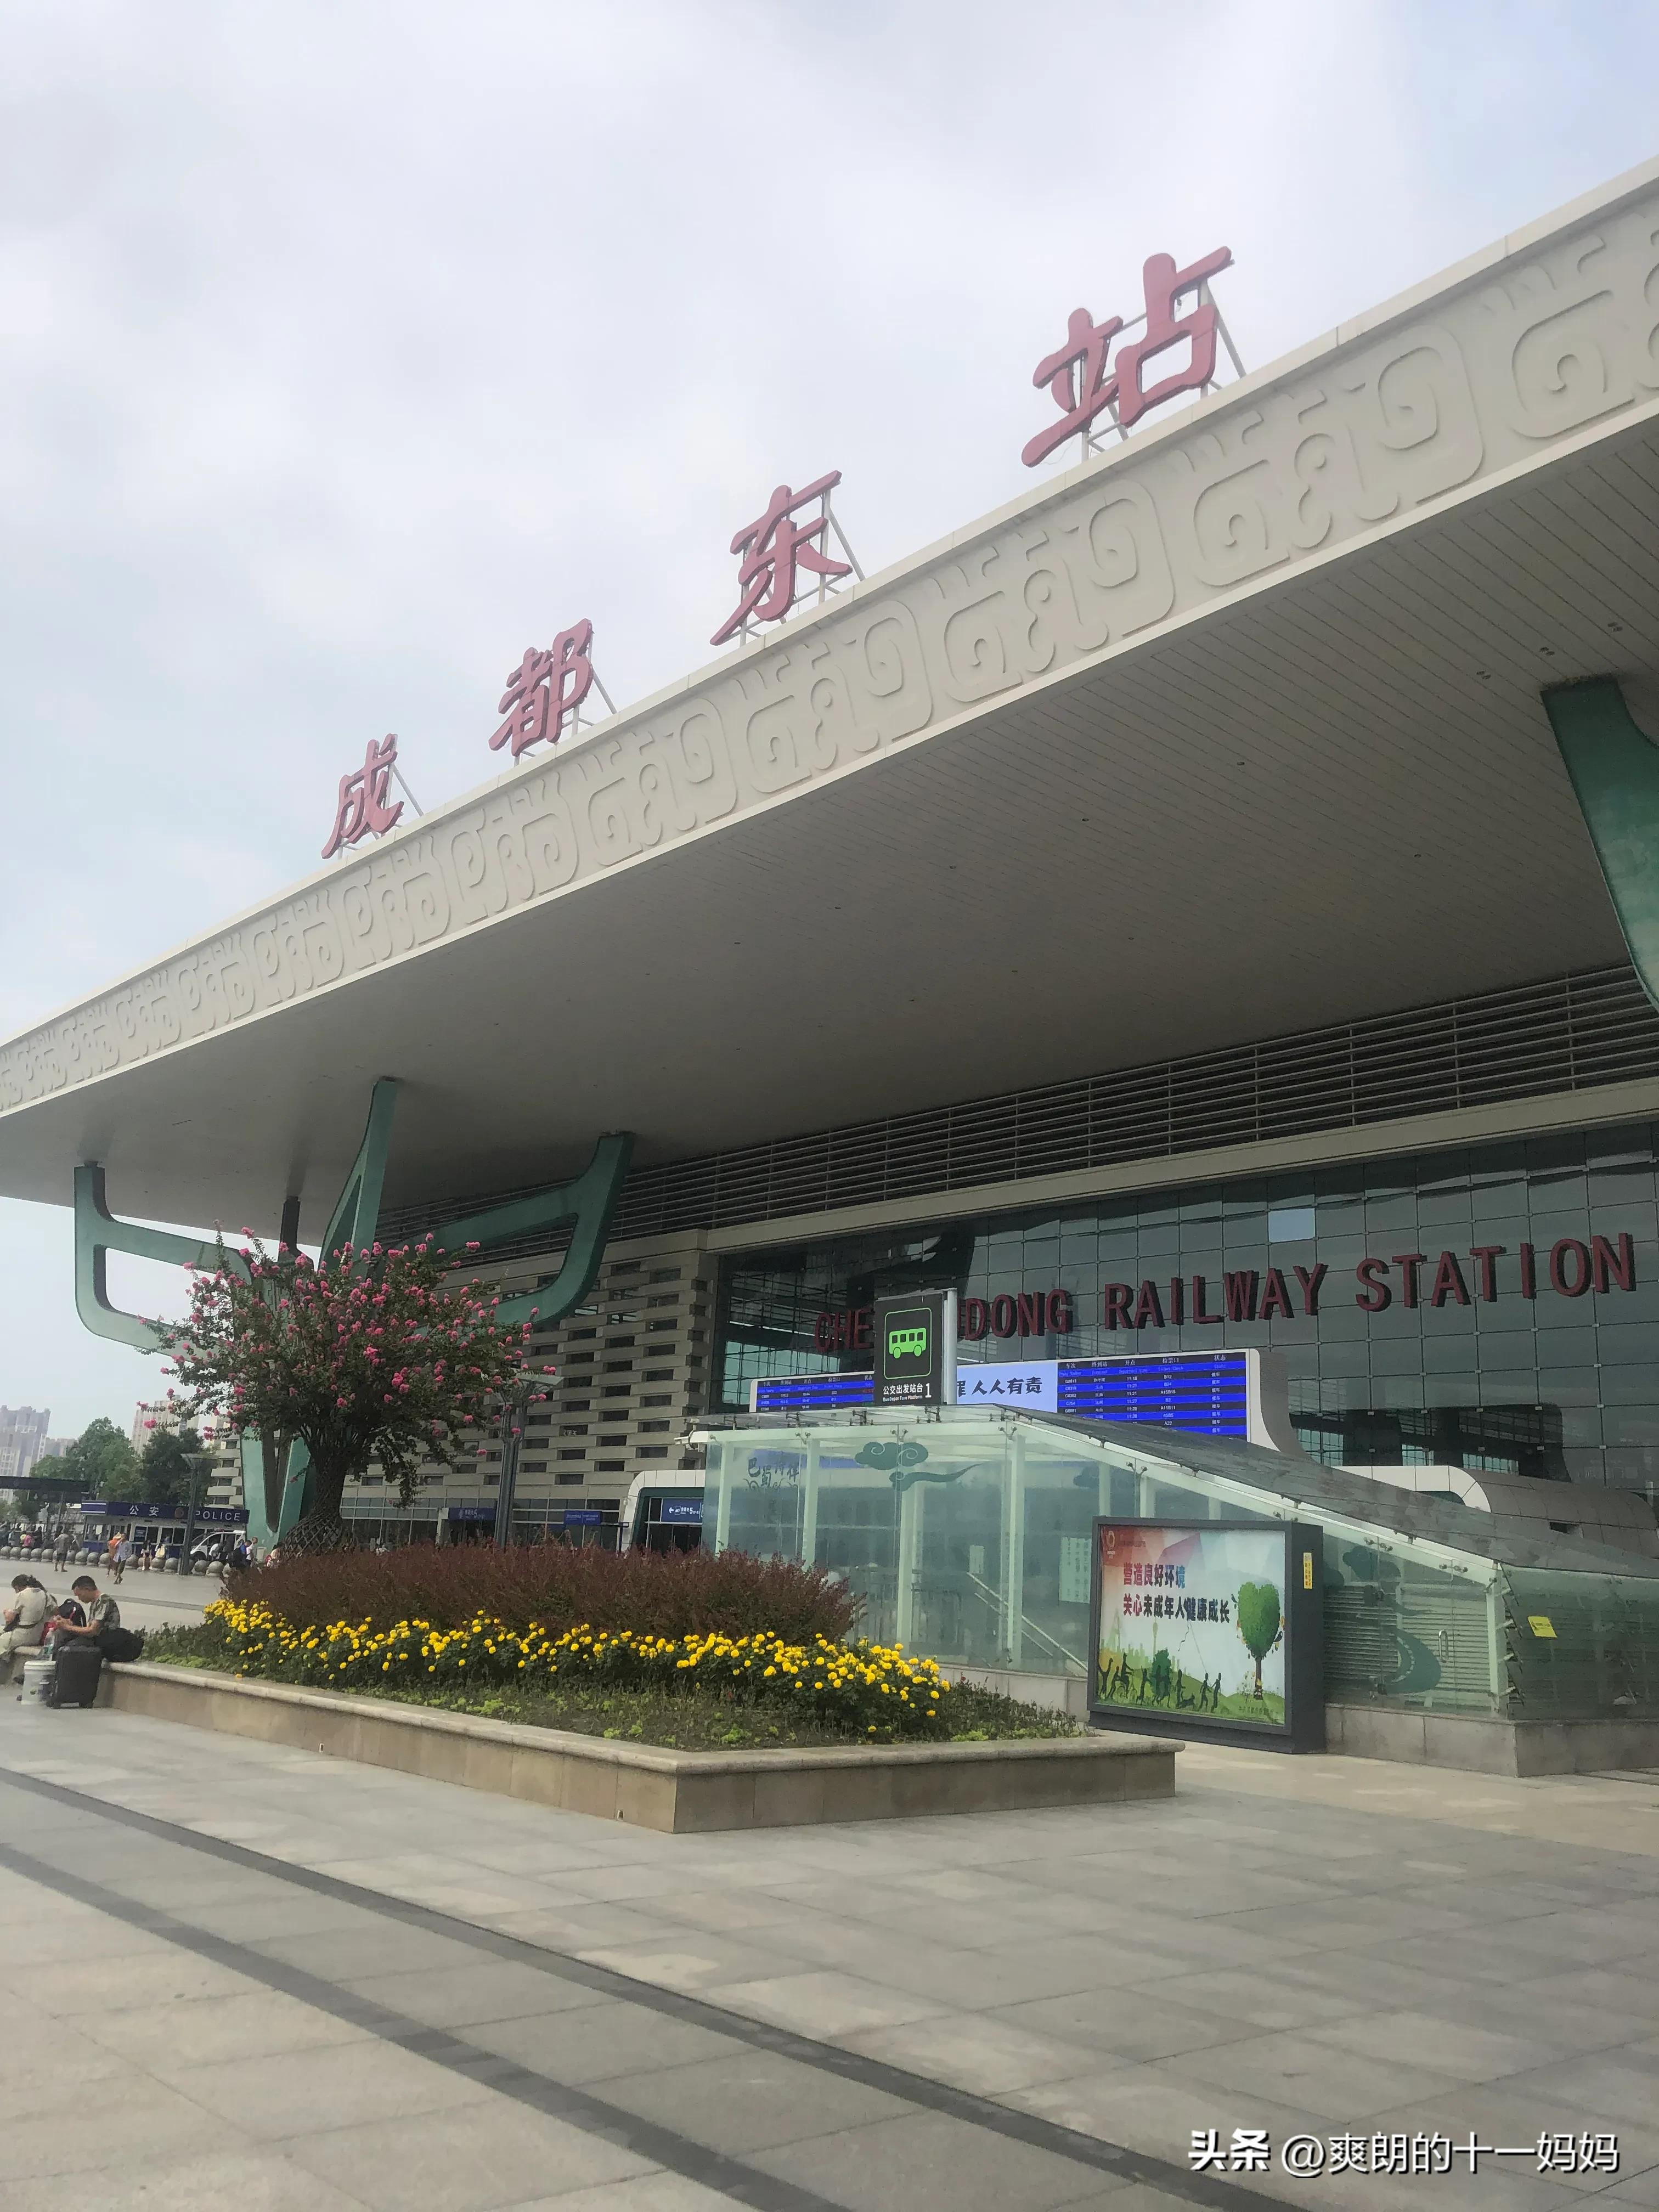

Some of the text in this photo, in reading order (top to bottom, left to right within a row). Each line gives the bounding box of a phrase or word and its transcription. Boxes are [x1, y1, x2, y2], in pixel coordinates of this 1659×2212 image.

[321, 246, 1234, 859] 成都东站
[1104, 1263, 1328, 1330] RAILWAY
[1356, 1232, 1636, 1312] STATION
[883, 1383, 932, 1398] 公交出发站台 1
[971, 1376, 1042, 1396] 人人有责
[129, 1505, 159, 1517] 公安
[1124, 1562, 1186, 1589] 营造良好环境
[1124, 1593, 1230, 1623] 关心未成年人健康成长
